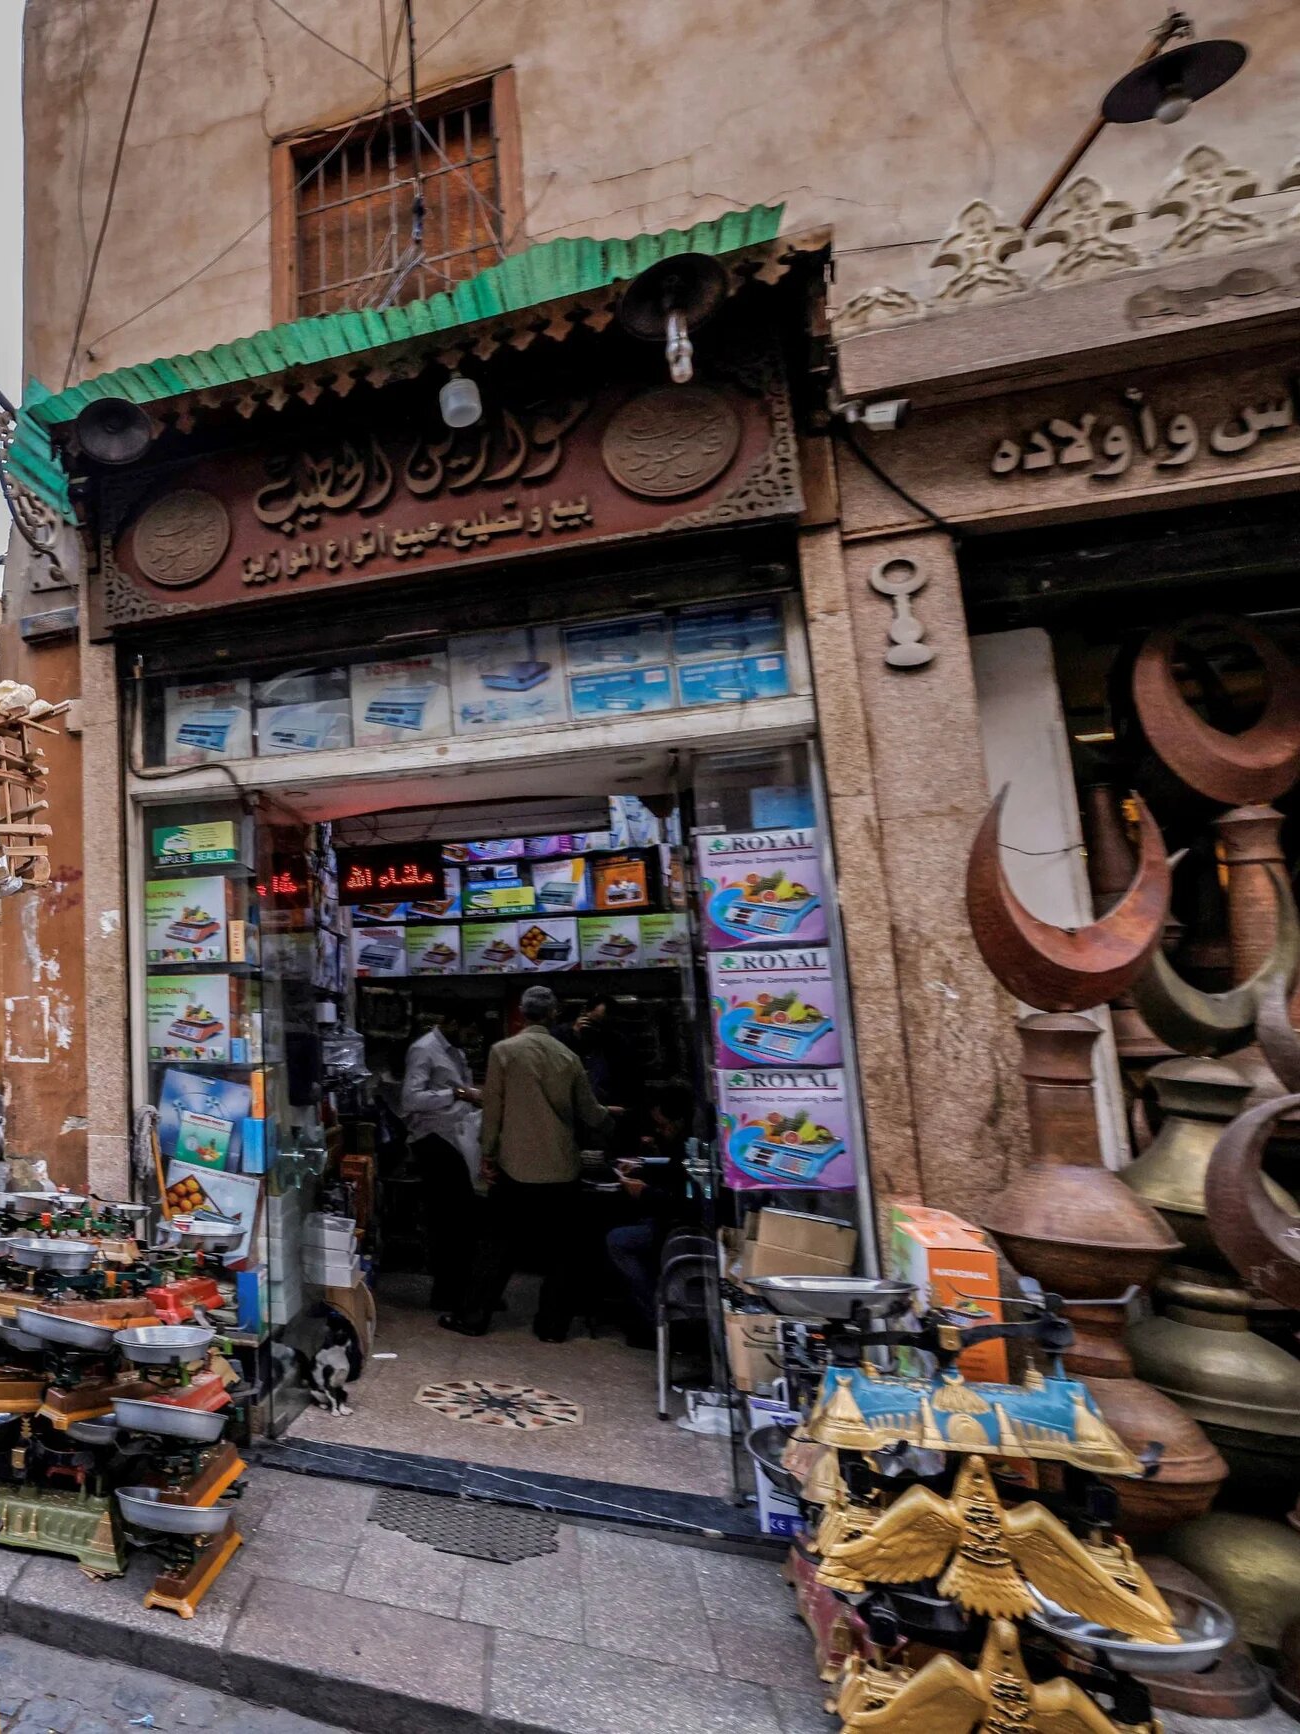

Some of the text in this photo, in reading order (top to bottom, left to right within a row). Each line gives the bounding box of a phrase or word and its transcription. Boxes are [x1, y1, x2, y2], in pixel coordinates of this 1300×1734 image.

[548, 496, 594, 532] بيع
[730, 831, 813, 851] ROYAL
[194, 849, 229, 861] SEALER
[347, 865, 373, 889] الله
[743, 952, 827, 970] ROYAL
[751, 1072, 838, 1088] ROYAL
